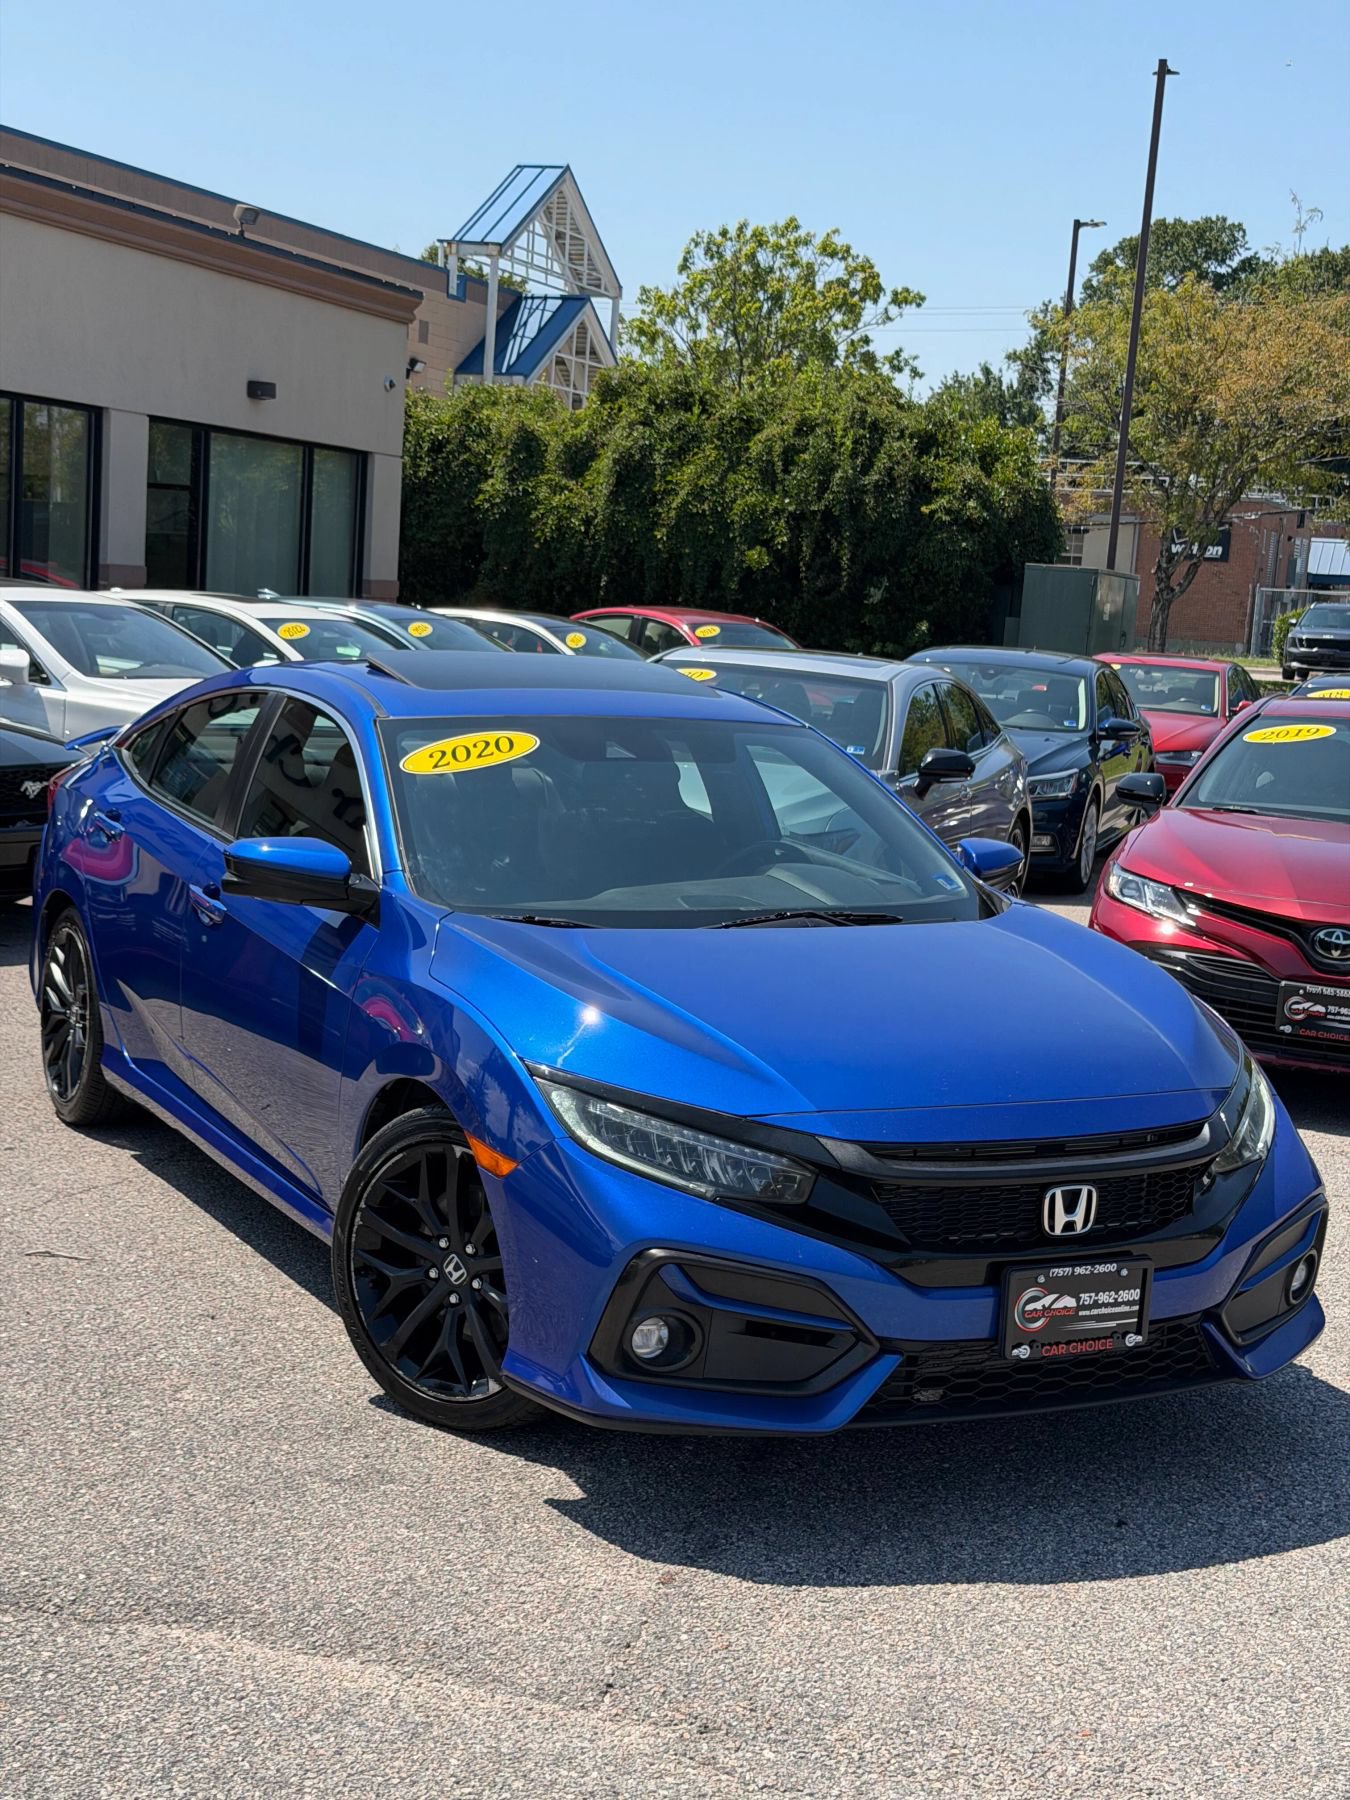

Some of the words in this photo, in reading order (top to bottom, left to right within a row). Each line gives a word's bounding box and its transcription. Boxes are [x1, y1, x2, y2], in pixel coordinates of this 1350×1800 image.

[1171, 542, 1223, 556] vion
[1260, 728, 1320, 741] 2019
[428, 735, 515, 769] 2020
[1299, 1028, 1317, 1038] CAR
[1049, 1267, 1072, 1278] (757)
[1074, 1263, 1118, 1275] 962-2600
[1079, 1288, 1140, 1306] 757-962-2600
[1024, 1310, 1043, 1318] CAR
[1044, 1307, 1077, 1317] CHOICE
[1041, 1344, 1067, 1357] CAR
[1069, 1338, 1114, 1354] CHOICE
